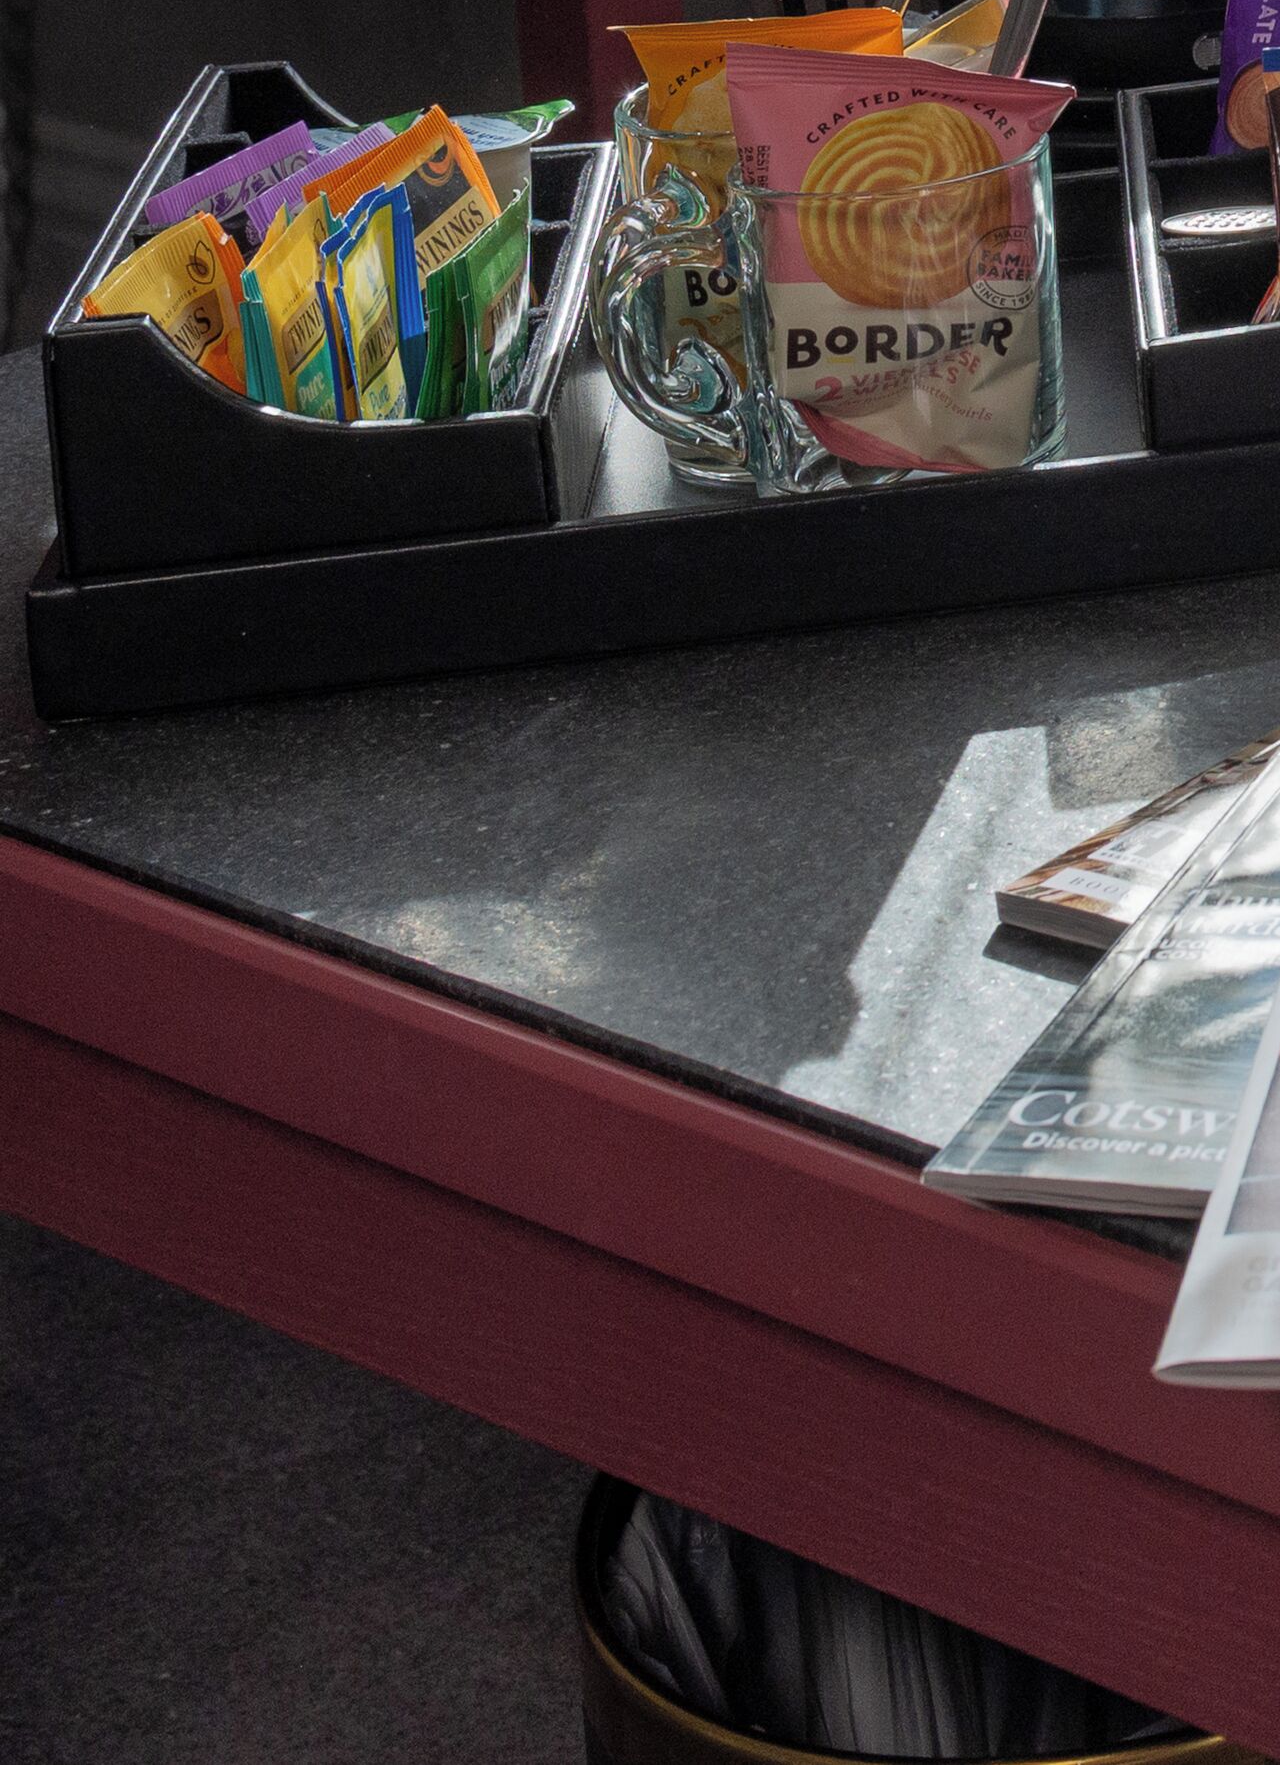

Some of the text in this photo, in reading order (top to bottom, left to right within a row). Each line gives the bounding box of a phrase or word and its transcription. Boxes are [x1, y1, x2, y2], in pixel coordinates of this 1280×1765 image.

[666, 54, 726, 97] CRAFT
[806, 87, 1018, 144] CRAFTED WITH CARE
[976, 282, 1007, 306] SINCE
[786, 317, 1013, 370] BORDER
[815, 376, 843, 403] 2
[1008, 1089, 1237, 1137] Cotsw
[1022, 1131, 1229, 1162] Discover a pict
